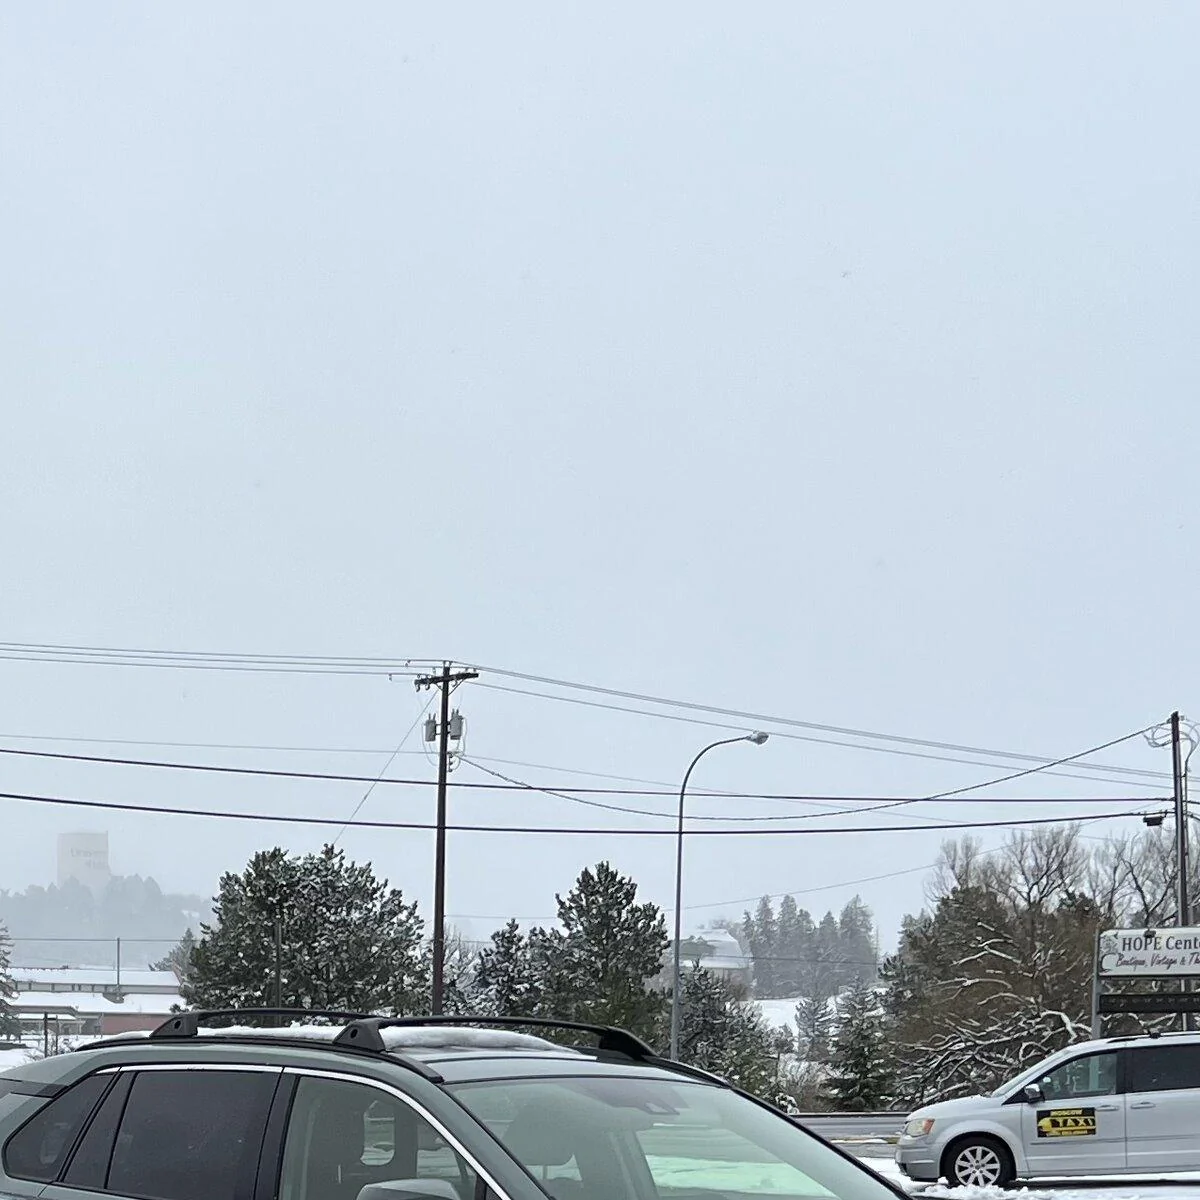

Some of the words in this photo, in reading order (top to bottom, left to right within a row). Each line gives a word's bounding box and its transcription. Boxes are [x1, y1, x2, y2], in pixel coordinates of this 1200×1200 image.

[1122, 936, 1162, 951] HOPE
[1166, 936, 1200, 950] Cent
[1057, 1117, 1093, 1127] TAXI
